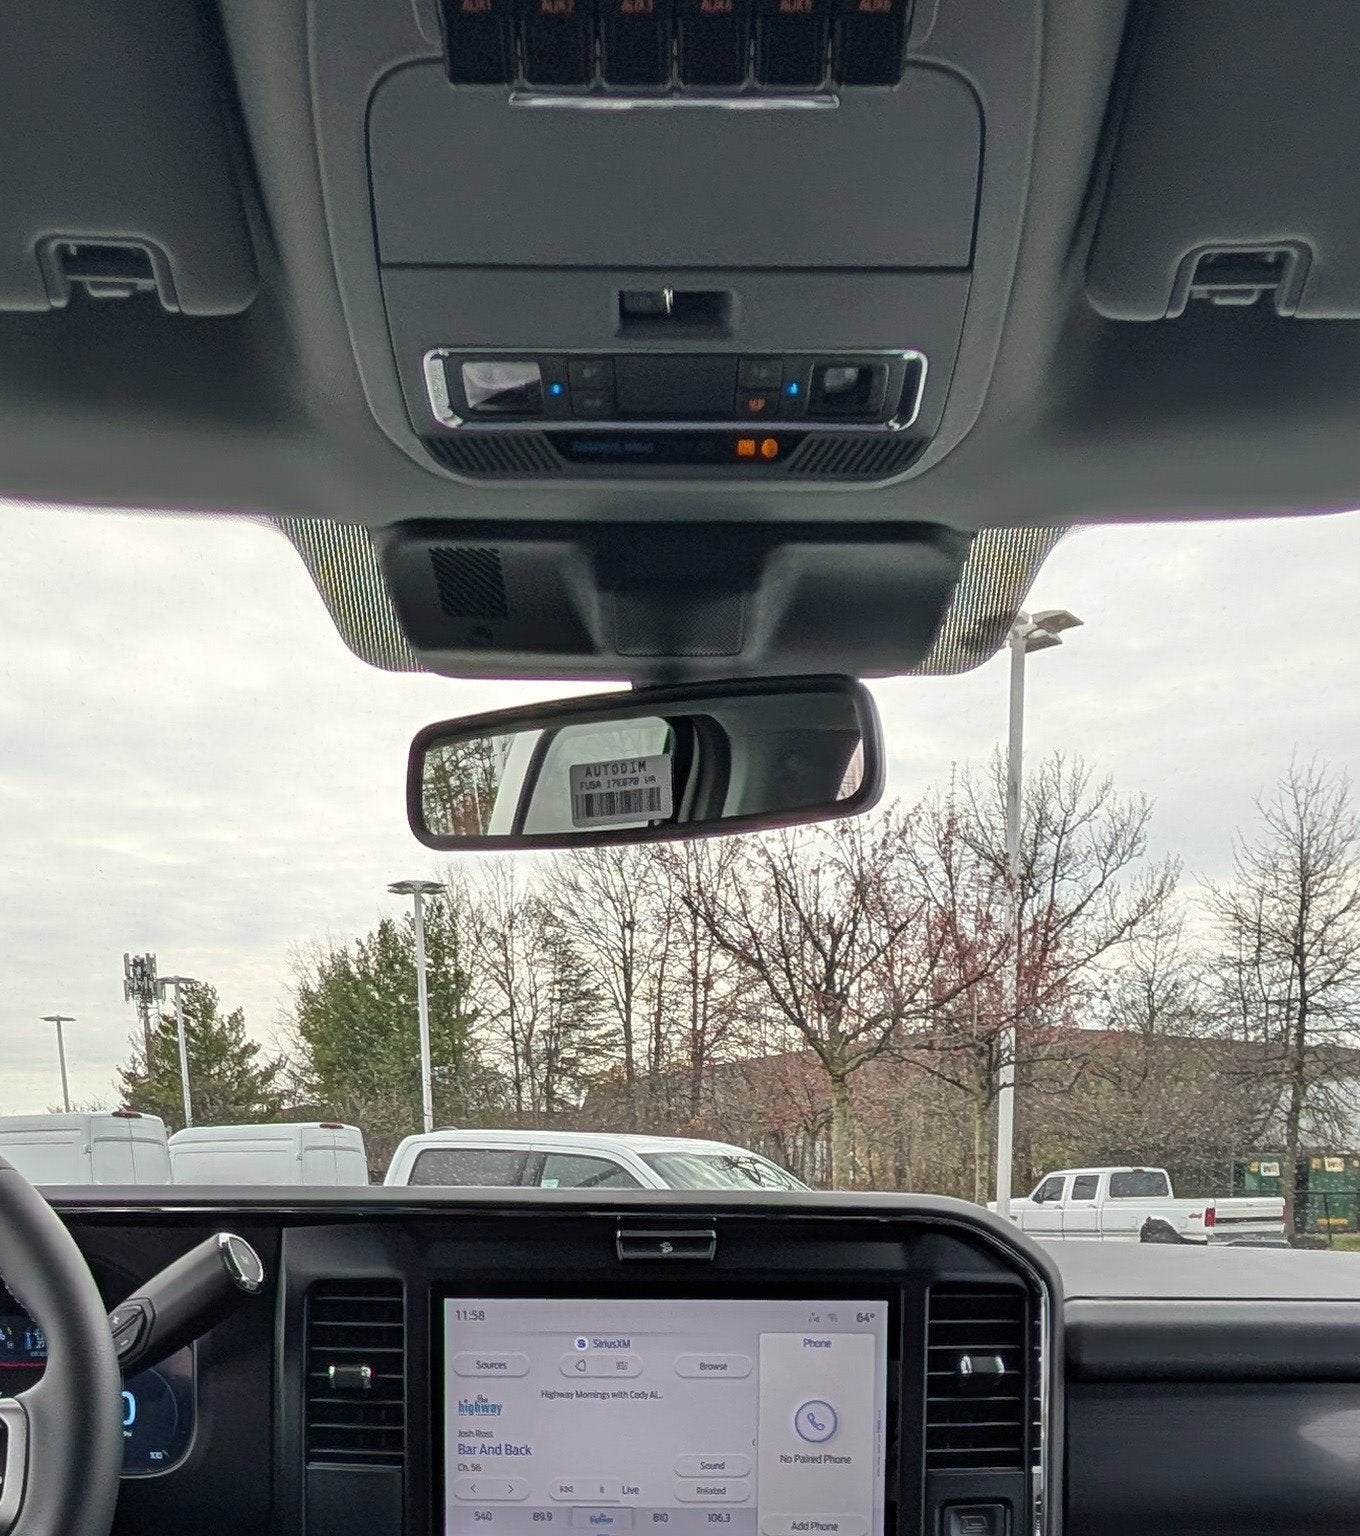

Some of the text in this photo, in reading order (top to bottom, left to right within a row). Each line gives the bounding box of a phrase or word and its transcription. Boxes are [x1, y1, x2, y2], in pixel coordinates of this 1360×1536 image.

[585, 760, 647, 778] AUTODIM
[456, 1310, 485, 1321] 11:58
[593, 1339, 631, 1349] SiriusXM
[803, 1338, 832, 1348] Phone
[476, 1360, 508, 1370] Sources
[700, 1361, 728, 1371] Browse
[541, 1390, 574, 1400] Highway
[575, 1390, 610, 1401] Mornings
[611, 1390, 629, 1399] with
[458, 1398, 503, 1416] highway
[458, 1444, 533, 1456] Bar And Back
[780, 1454, 853, 1464] No Paired Phone
[700, 1460, 725, 1470] Sound
[621, 1485, 640, 1495] Live
[791, 1521, 839, 1532] Add Phone
